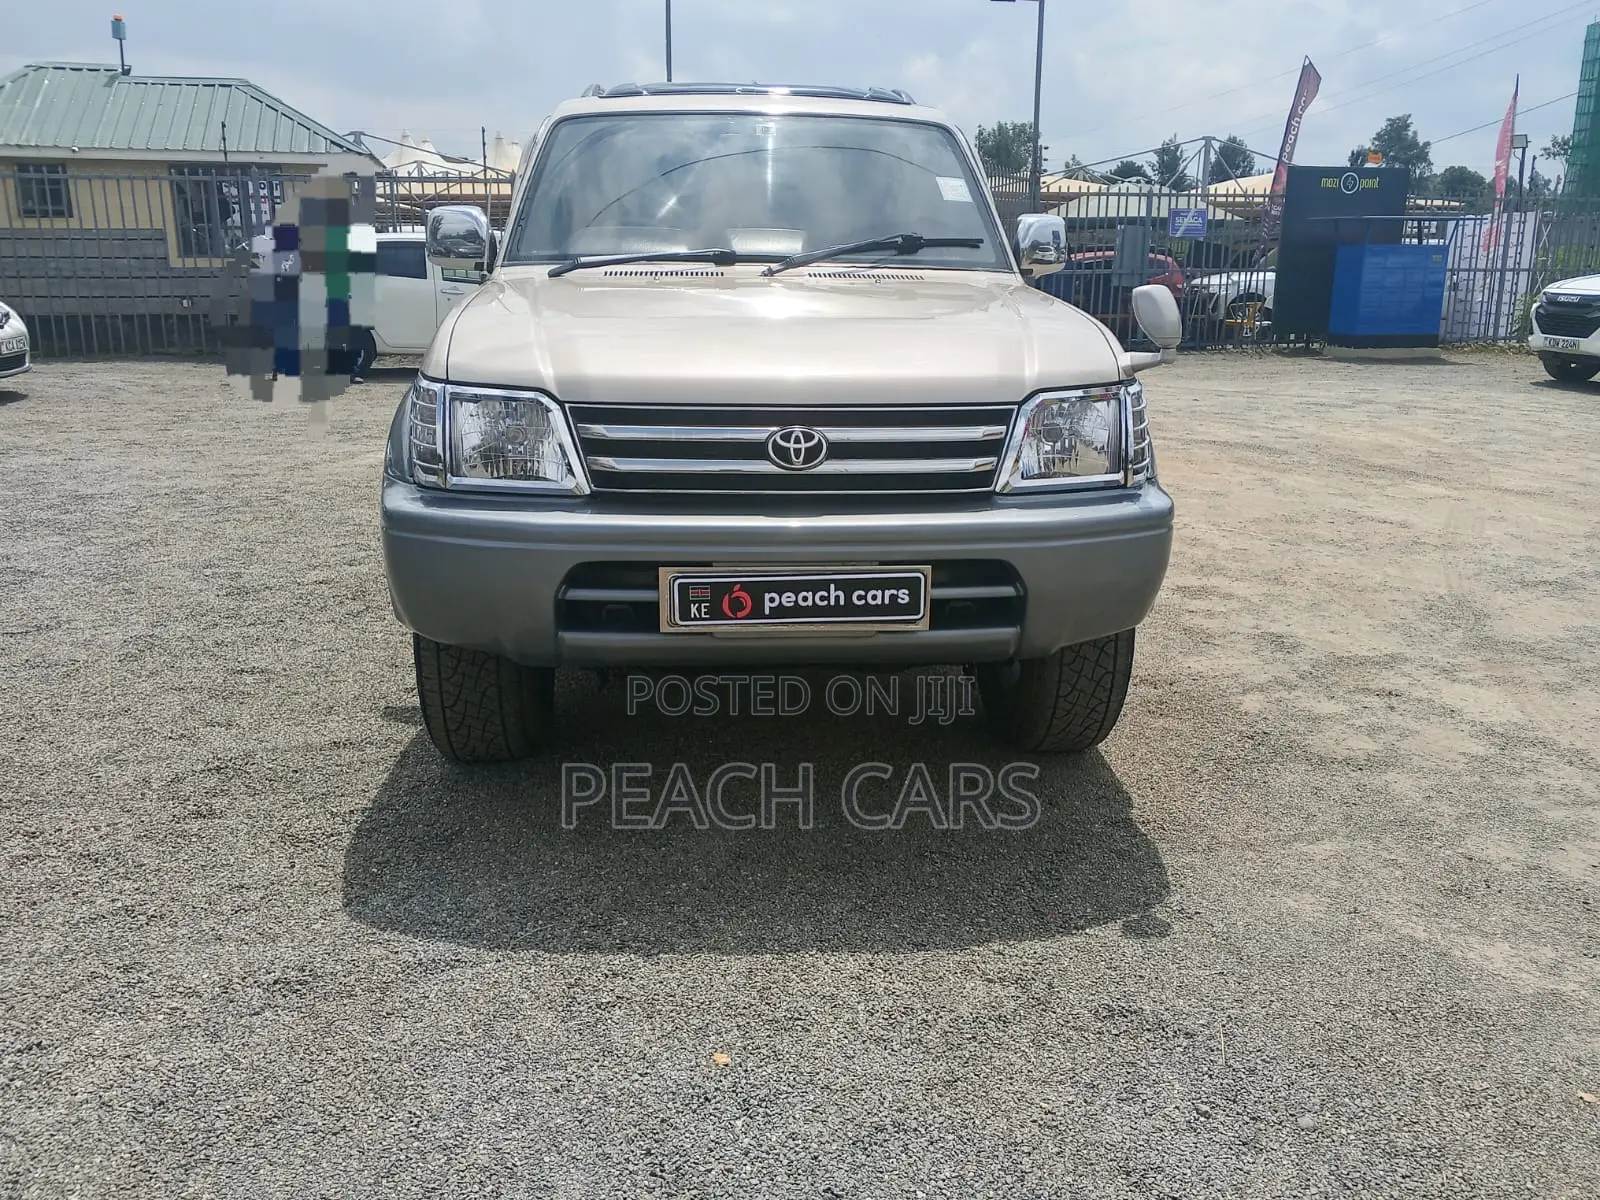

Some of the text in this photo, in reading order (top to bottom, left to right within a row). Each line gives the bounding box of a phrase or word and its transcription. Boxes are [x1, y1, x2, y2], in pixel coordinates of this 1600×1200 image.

[1282, 117, 1301, 163] peach
[1359, 176, 1380, 191] point
[690, 603, 710, 618] KE
[764, 584, 910, 615] peach cars
